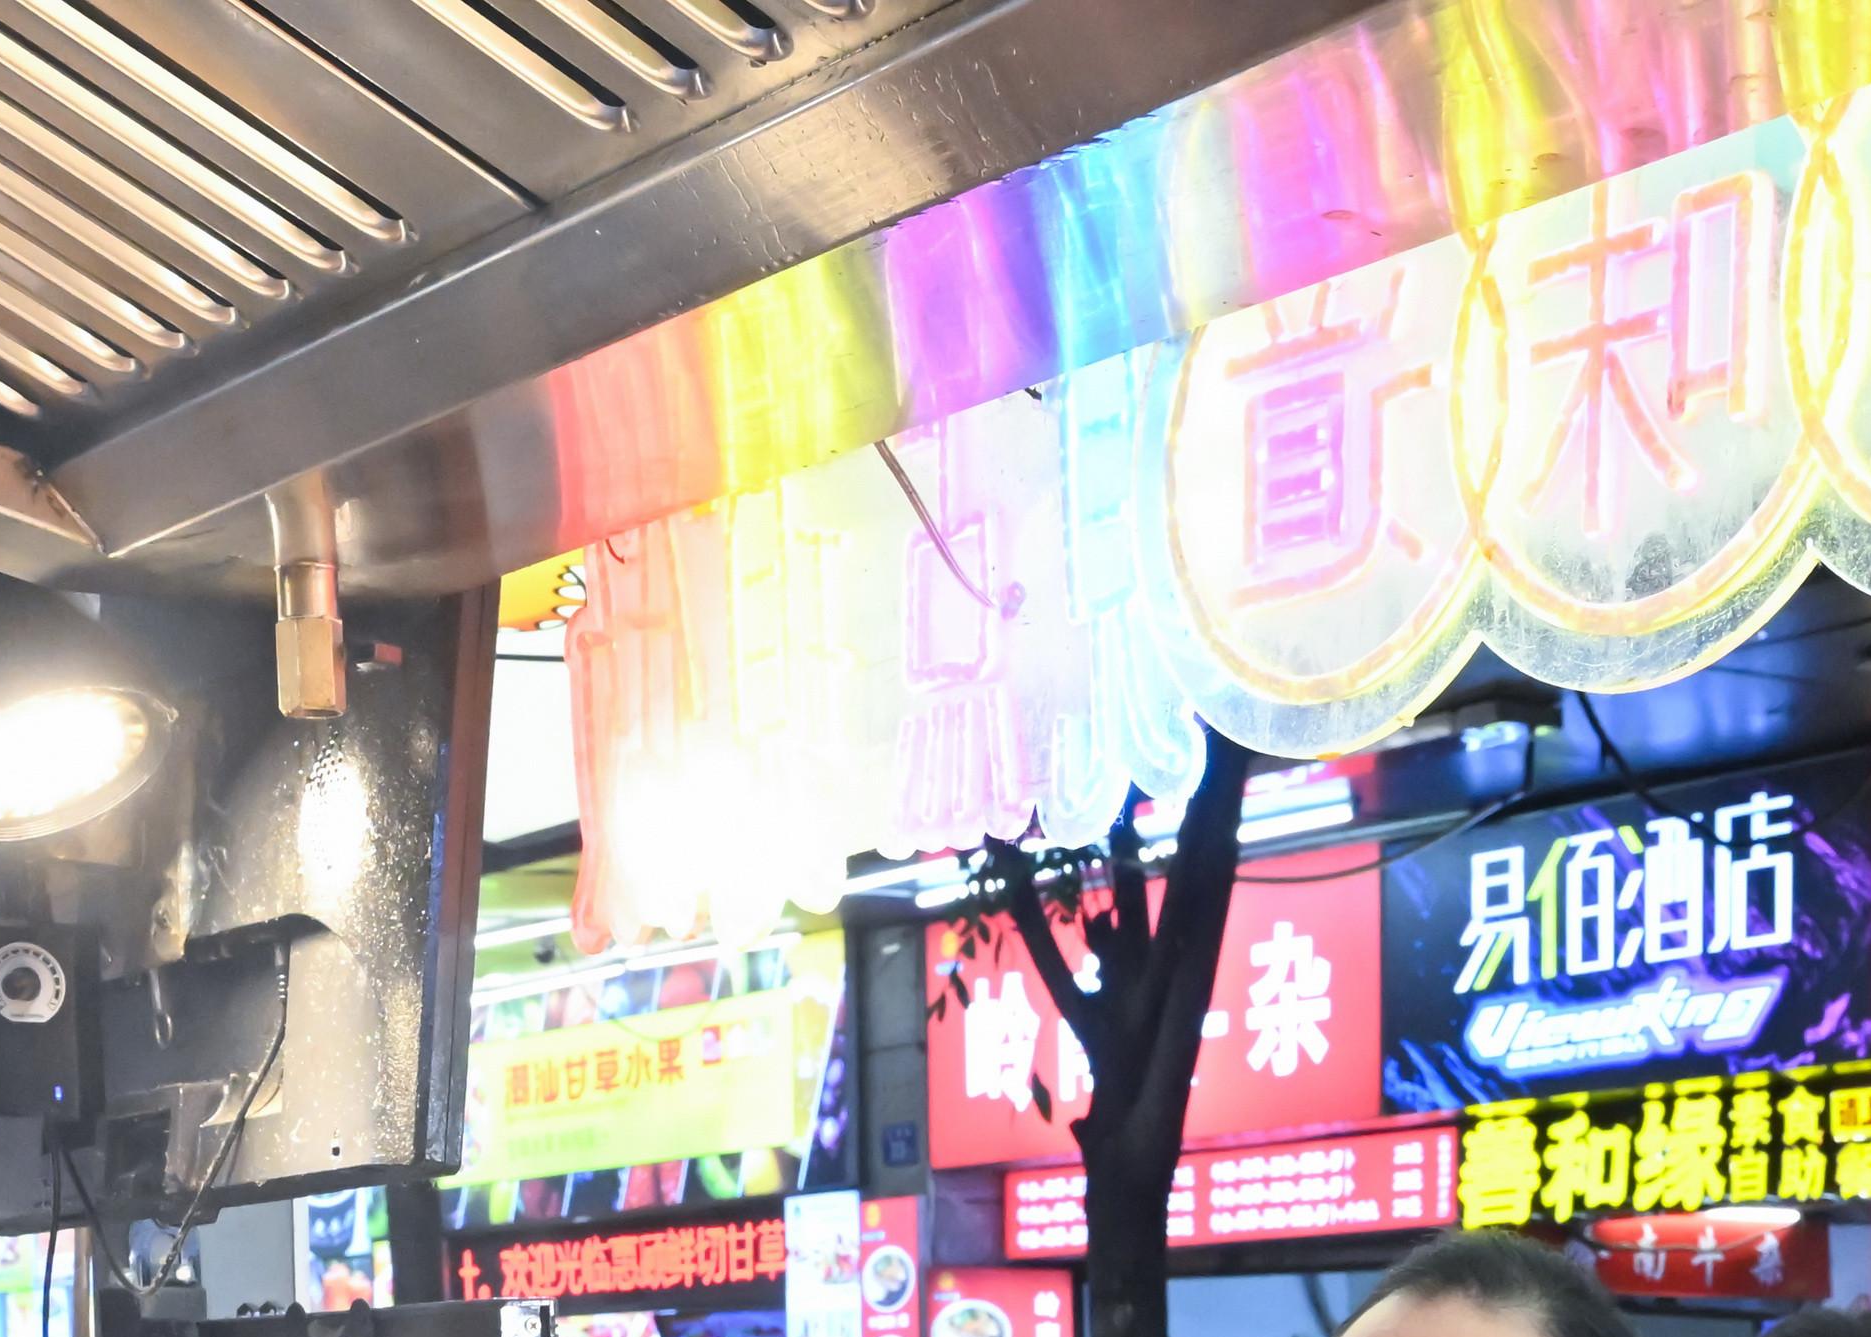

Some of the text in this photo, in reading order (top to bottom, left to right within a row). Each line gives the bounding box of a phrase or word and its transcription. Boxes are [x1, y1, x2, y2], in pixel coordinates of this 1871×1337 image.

[1453, 790, 1795, 995] 易佰酒店
[1458, 1108, 1728, 1232] 善和缘
